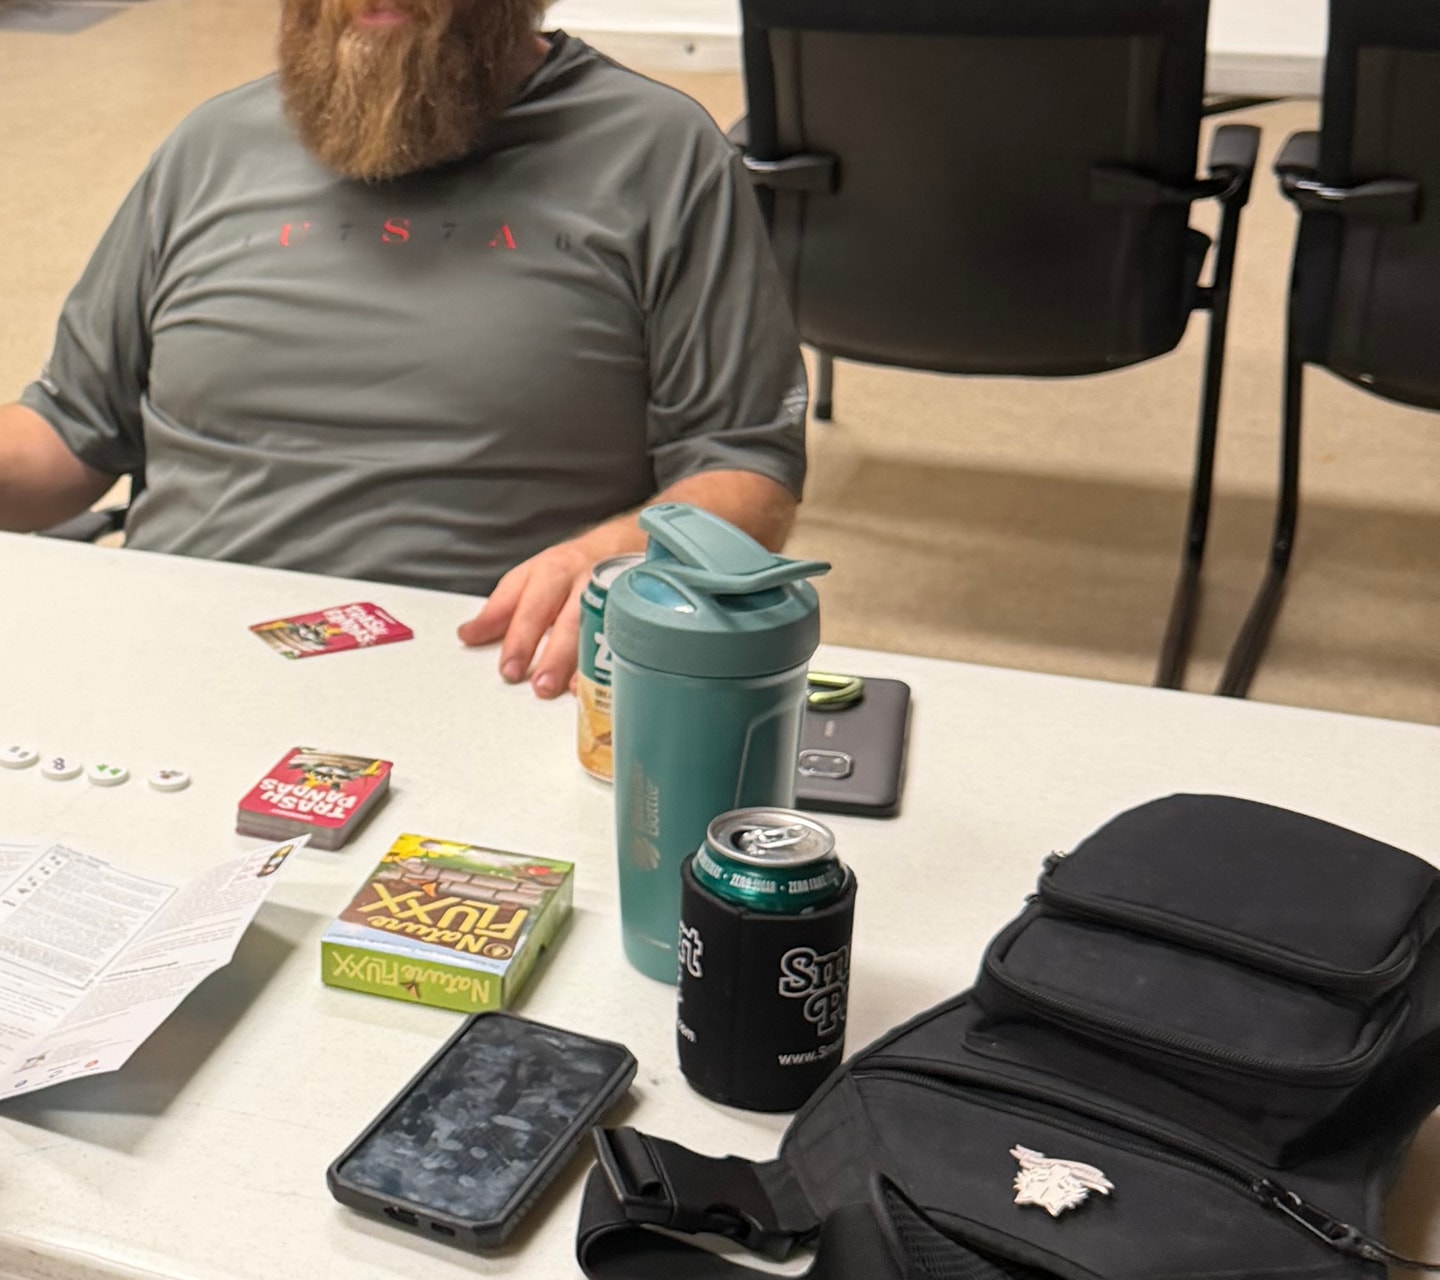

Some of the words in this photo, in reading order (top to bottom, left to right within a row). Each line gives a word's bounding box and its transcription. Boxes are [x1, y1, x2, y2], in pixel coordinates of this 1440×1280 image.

[259, 777, 359, 809] PANDAS
[260, 788, 347, 819] TRASH
[357, 881, 529, 940] FLUXX
[368, 913, 489, 954] Nature
[401, 964, 490, 1004] Nature
[778, 945, 850, 999] Sm
